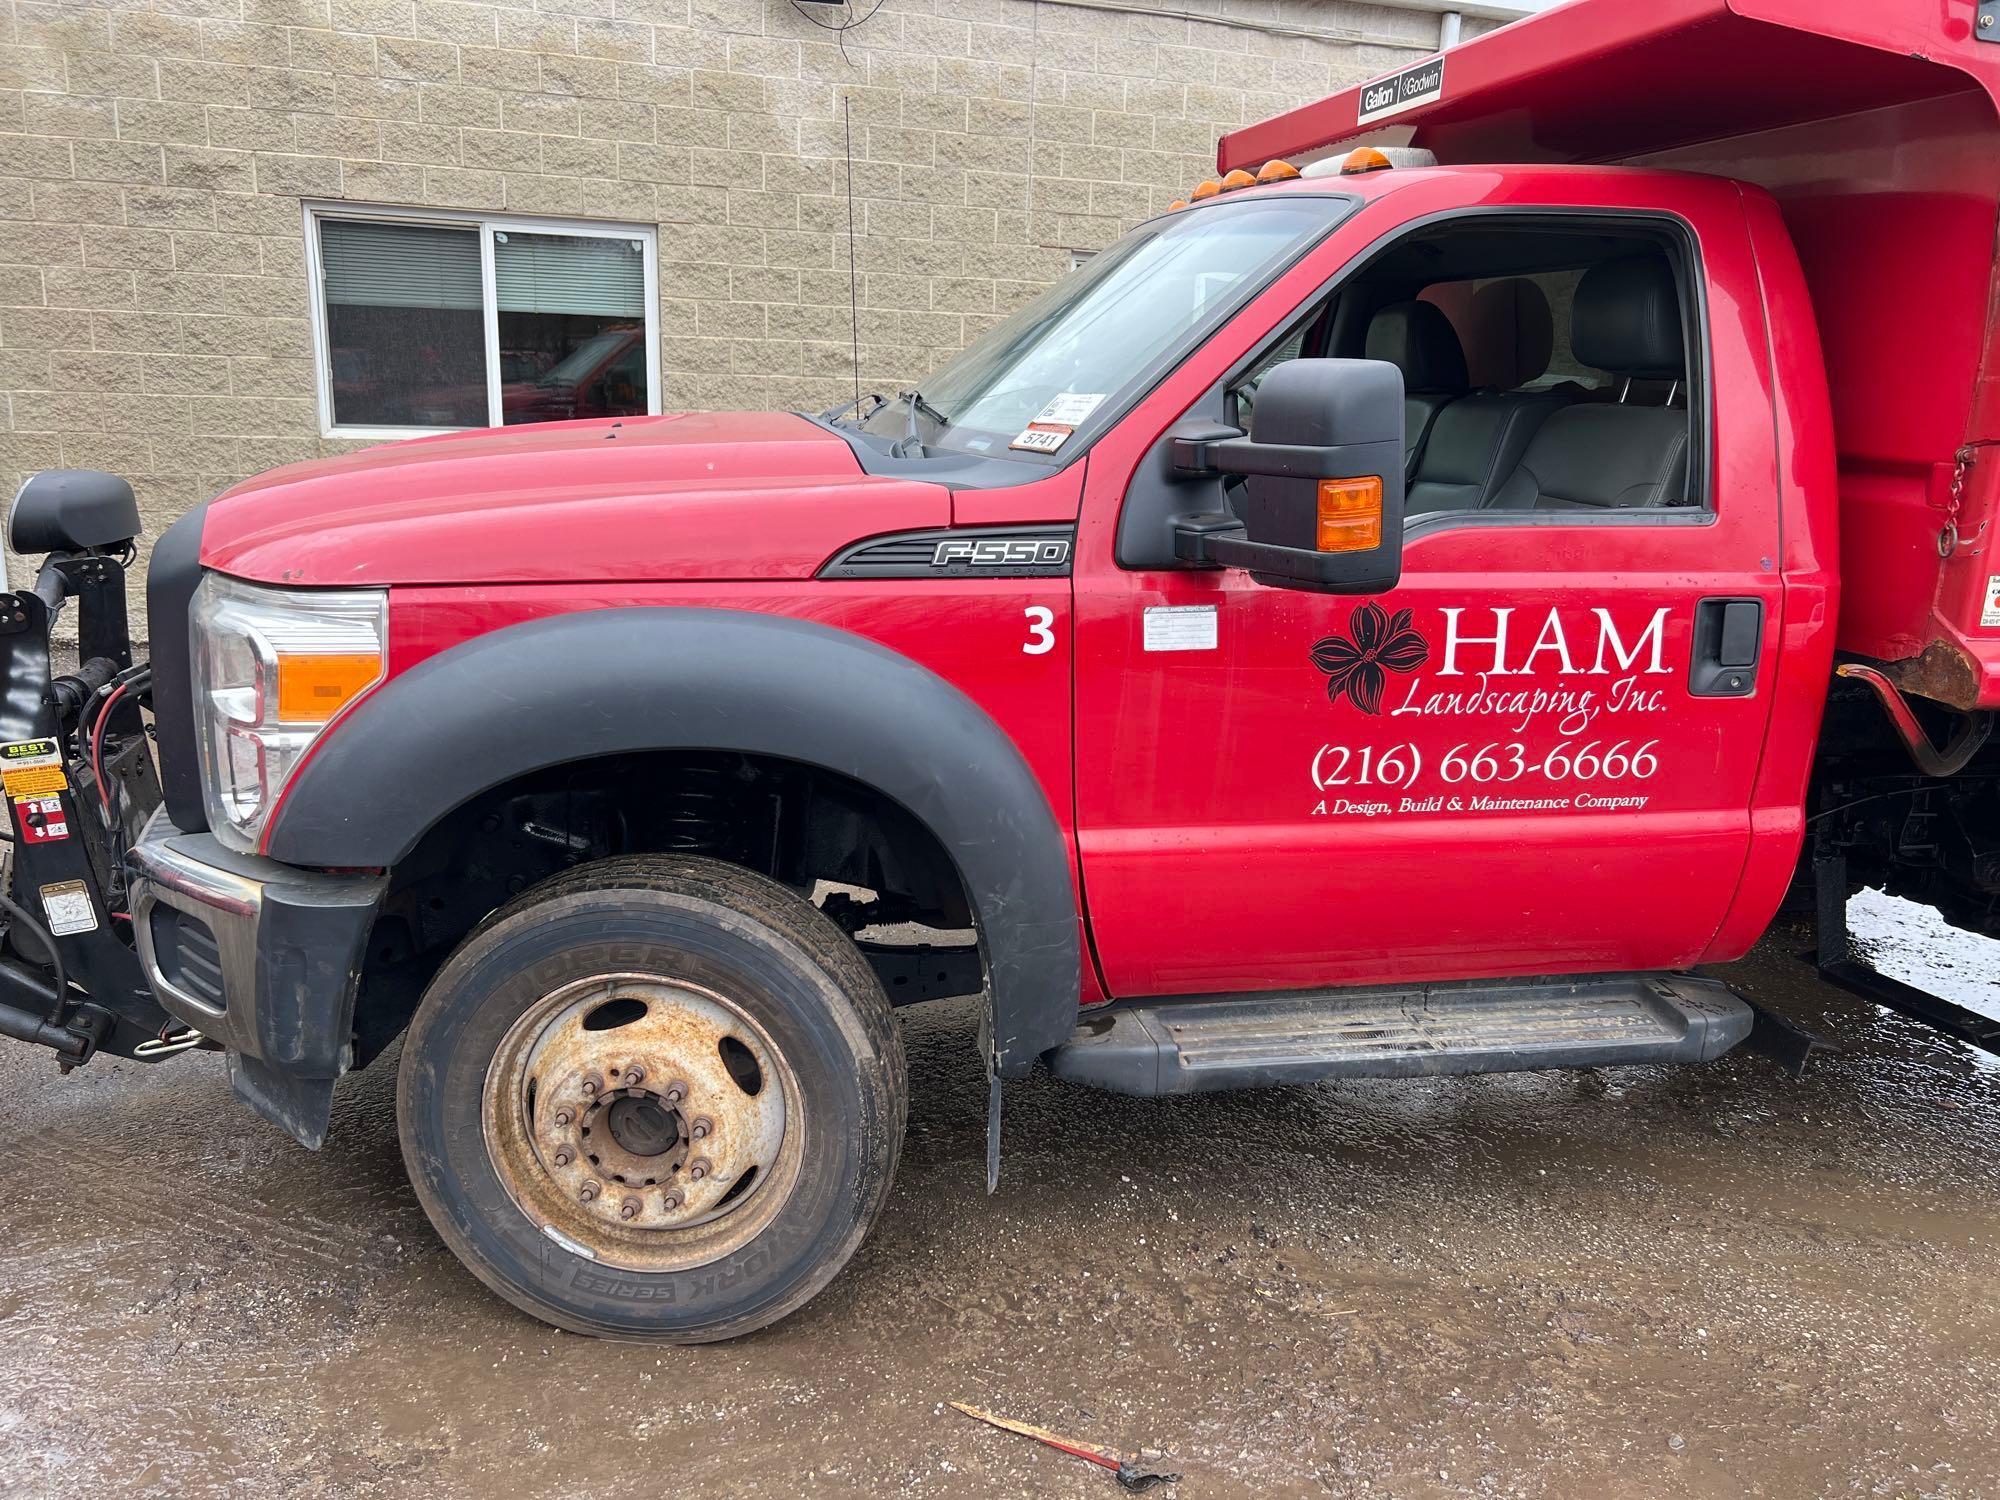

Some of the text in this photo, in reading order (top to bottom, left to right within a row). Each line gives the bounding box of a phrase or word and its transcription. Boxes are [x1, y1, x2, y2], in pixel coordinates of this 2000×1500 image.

[1365, 69, 1439, 111] Galion Godwin
[1023, 433, 1058, 447] 5741
[933, 541, 1069, 567] F-550
[935, 568, 1001, 576] SUPER
[1013, 567, 1064, 576] DUTY
[1022, 605, 1056, 655] 3
[1435, 607, 1674, 676] H.A.M.
[1390, 672, 1667, 735] Landscaping, Inc.
[8, 743, 46, 753] BEST
[1311, 740, 1660, 791] (216) 663-6666
[1311, 793, 1649, 816] A Design, Build & Maintenance Company
